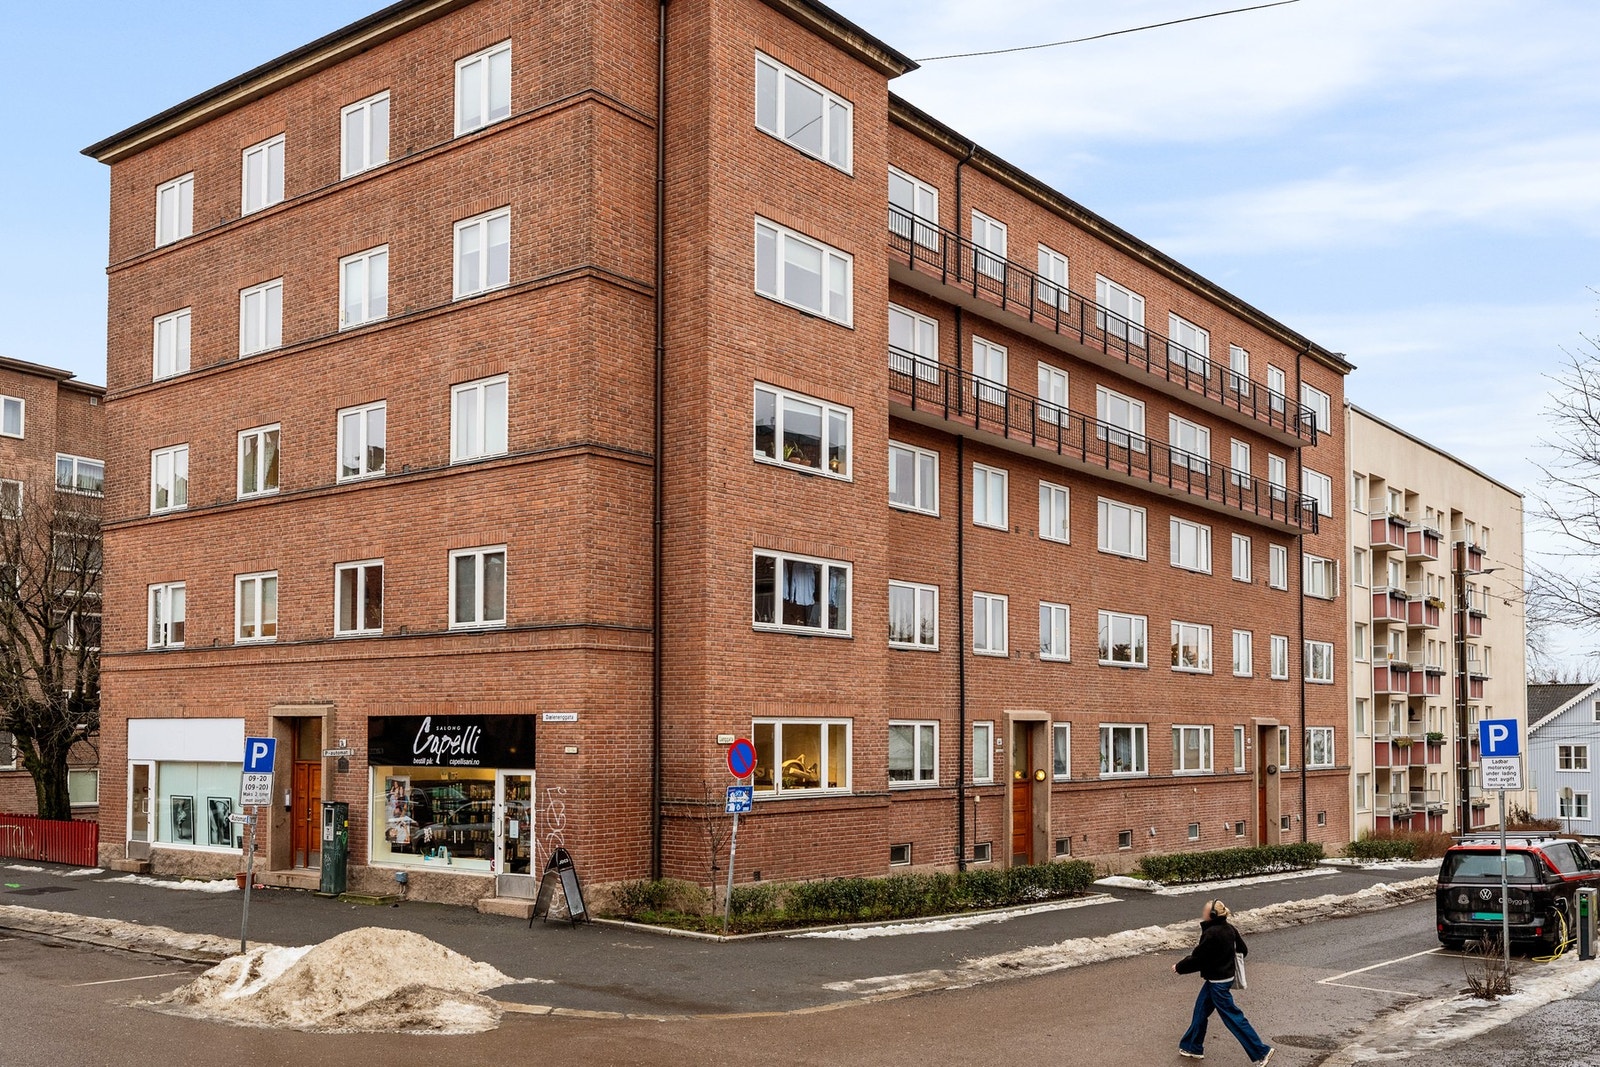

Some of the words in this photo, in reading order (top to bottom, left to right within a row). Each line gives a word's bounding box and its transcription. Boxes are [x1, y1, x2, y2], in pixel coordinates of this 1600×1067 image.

[413, 716, 481, 764] Capelli
[1488, 724, 1509, 752] P
[251, 742, 268, 768] P
[449, 758, 481, 766] capellisani.no
[245, 783, 269, 791] (09-20)
